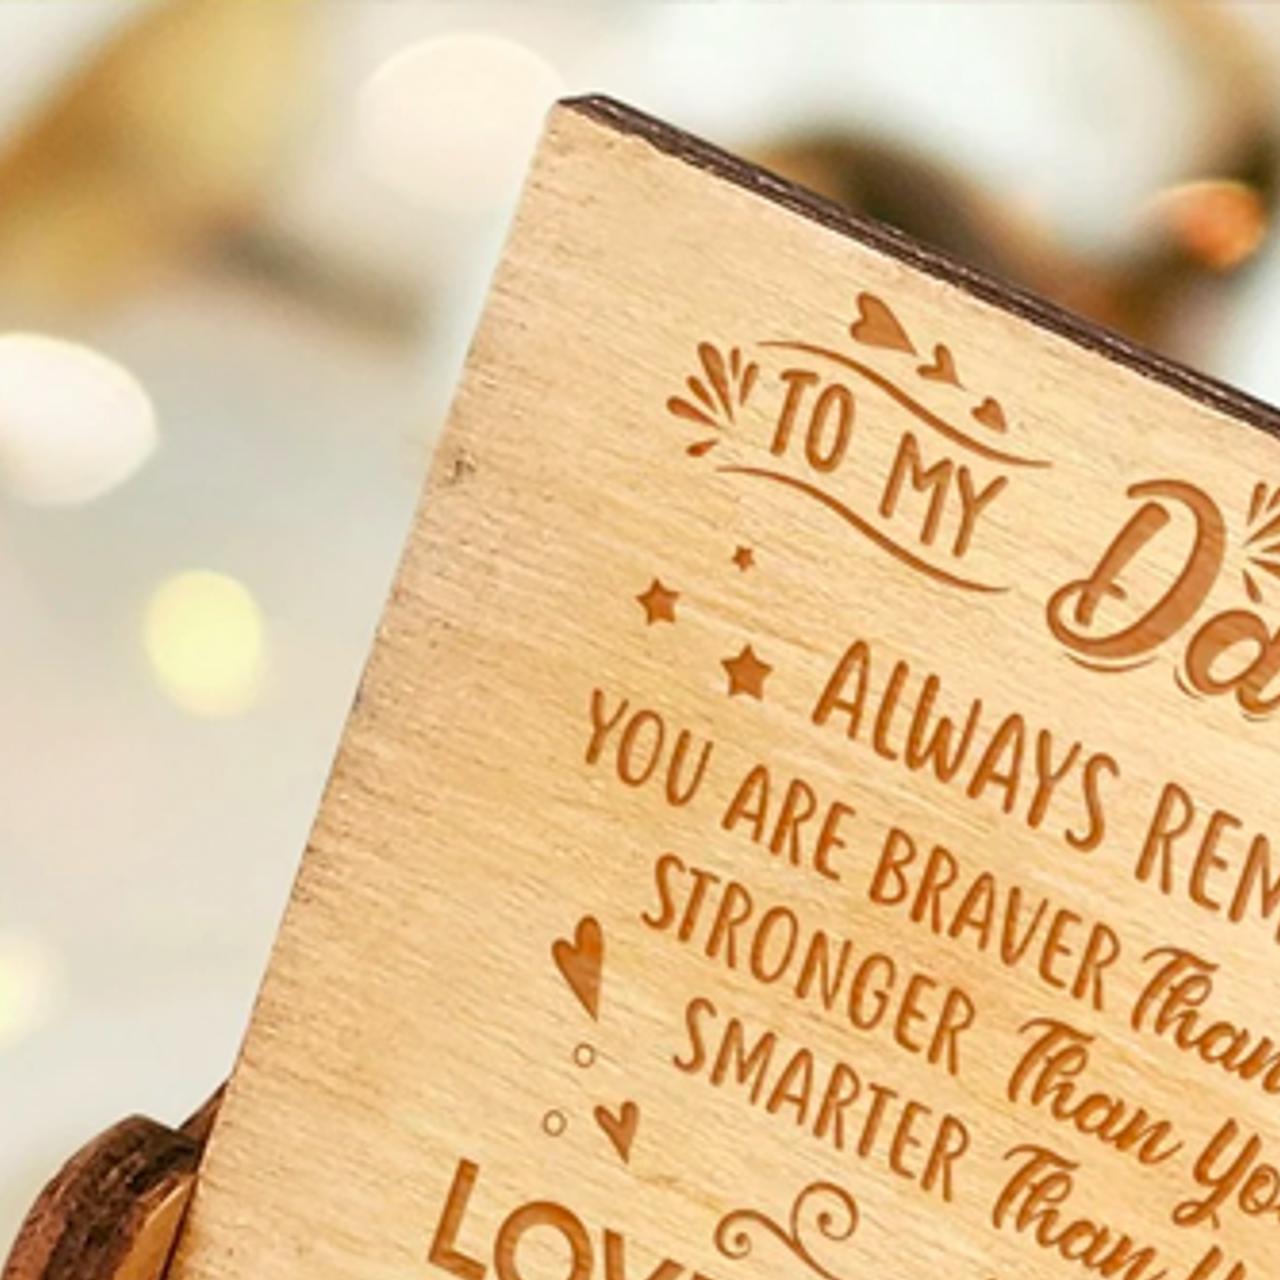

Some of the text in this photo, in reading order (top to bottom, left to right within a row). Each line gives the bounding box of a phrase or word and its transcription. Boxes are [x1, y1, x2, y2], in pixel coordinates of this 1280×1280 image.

[766, 367, 1008, 558] TO MY
[584, 688, 713, 807] YOU
[721, 763, 855, 883] ARE
[868, 828, 1121, 1011] BRAVER
[812, 640, 1120, 850] ALWAYS
[640, 854, 976, 1076] STRONGER
[1003, 1017, 1181, 1166] Than
[672, 998, 972, 1203] SMARTER
